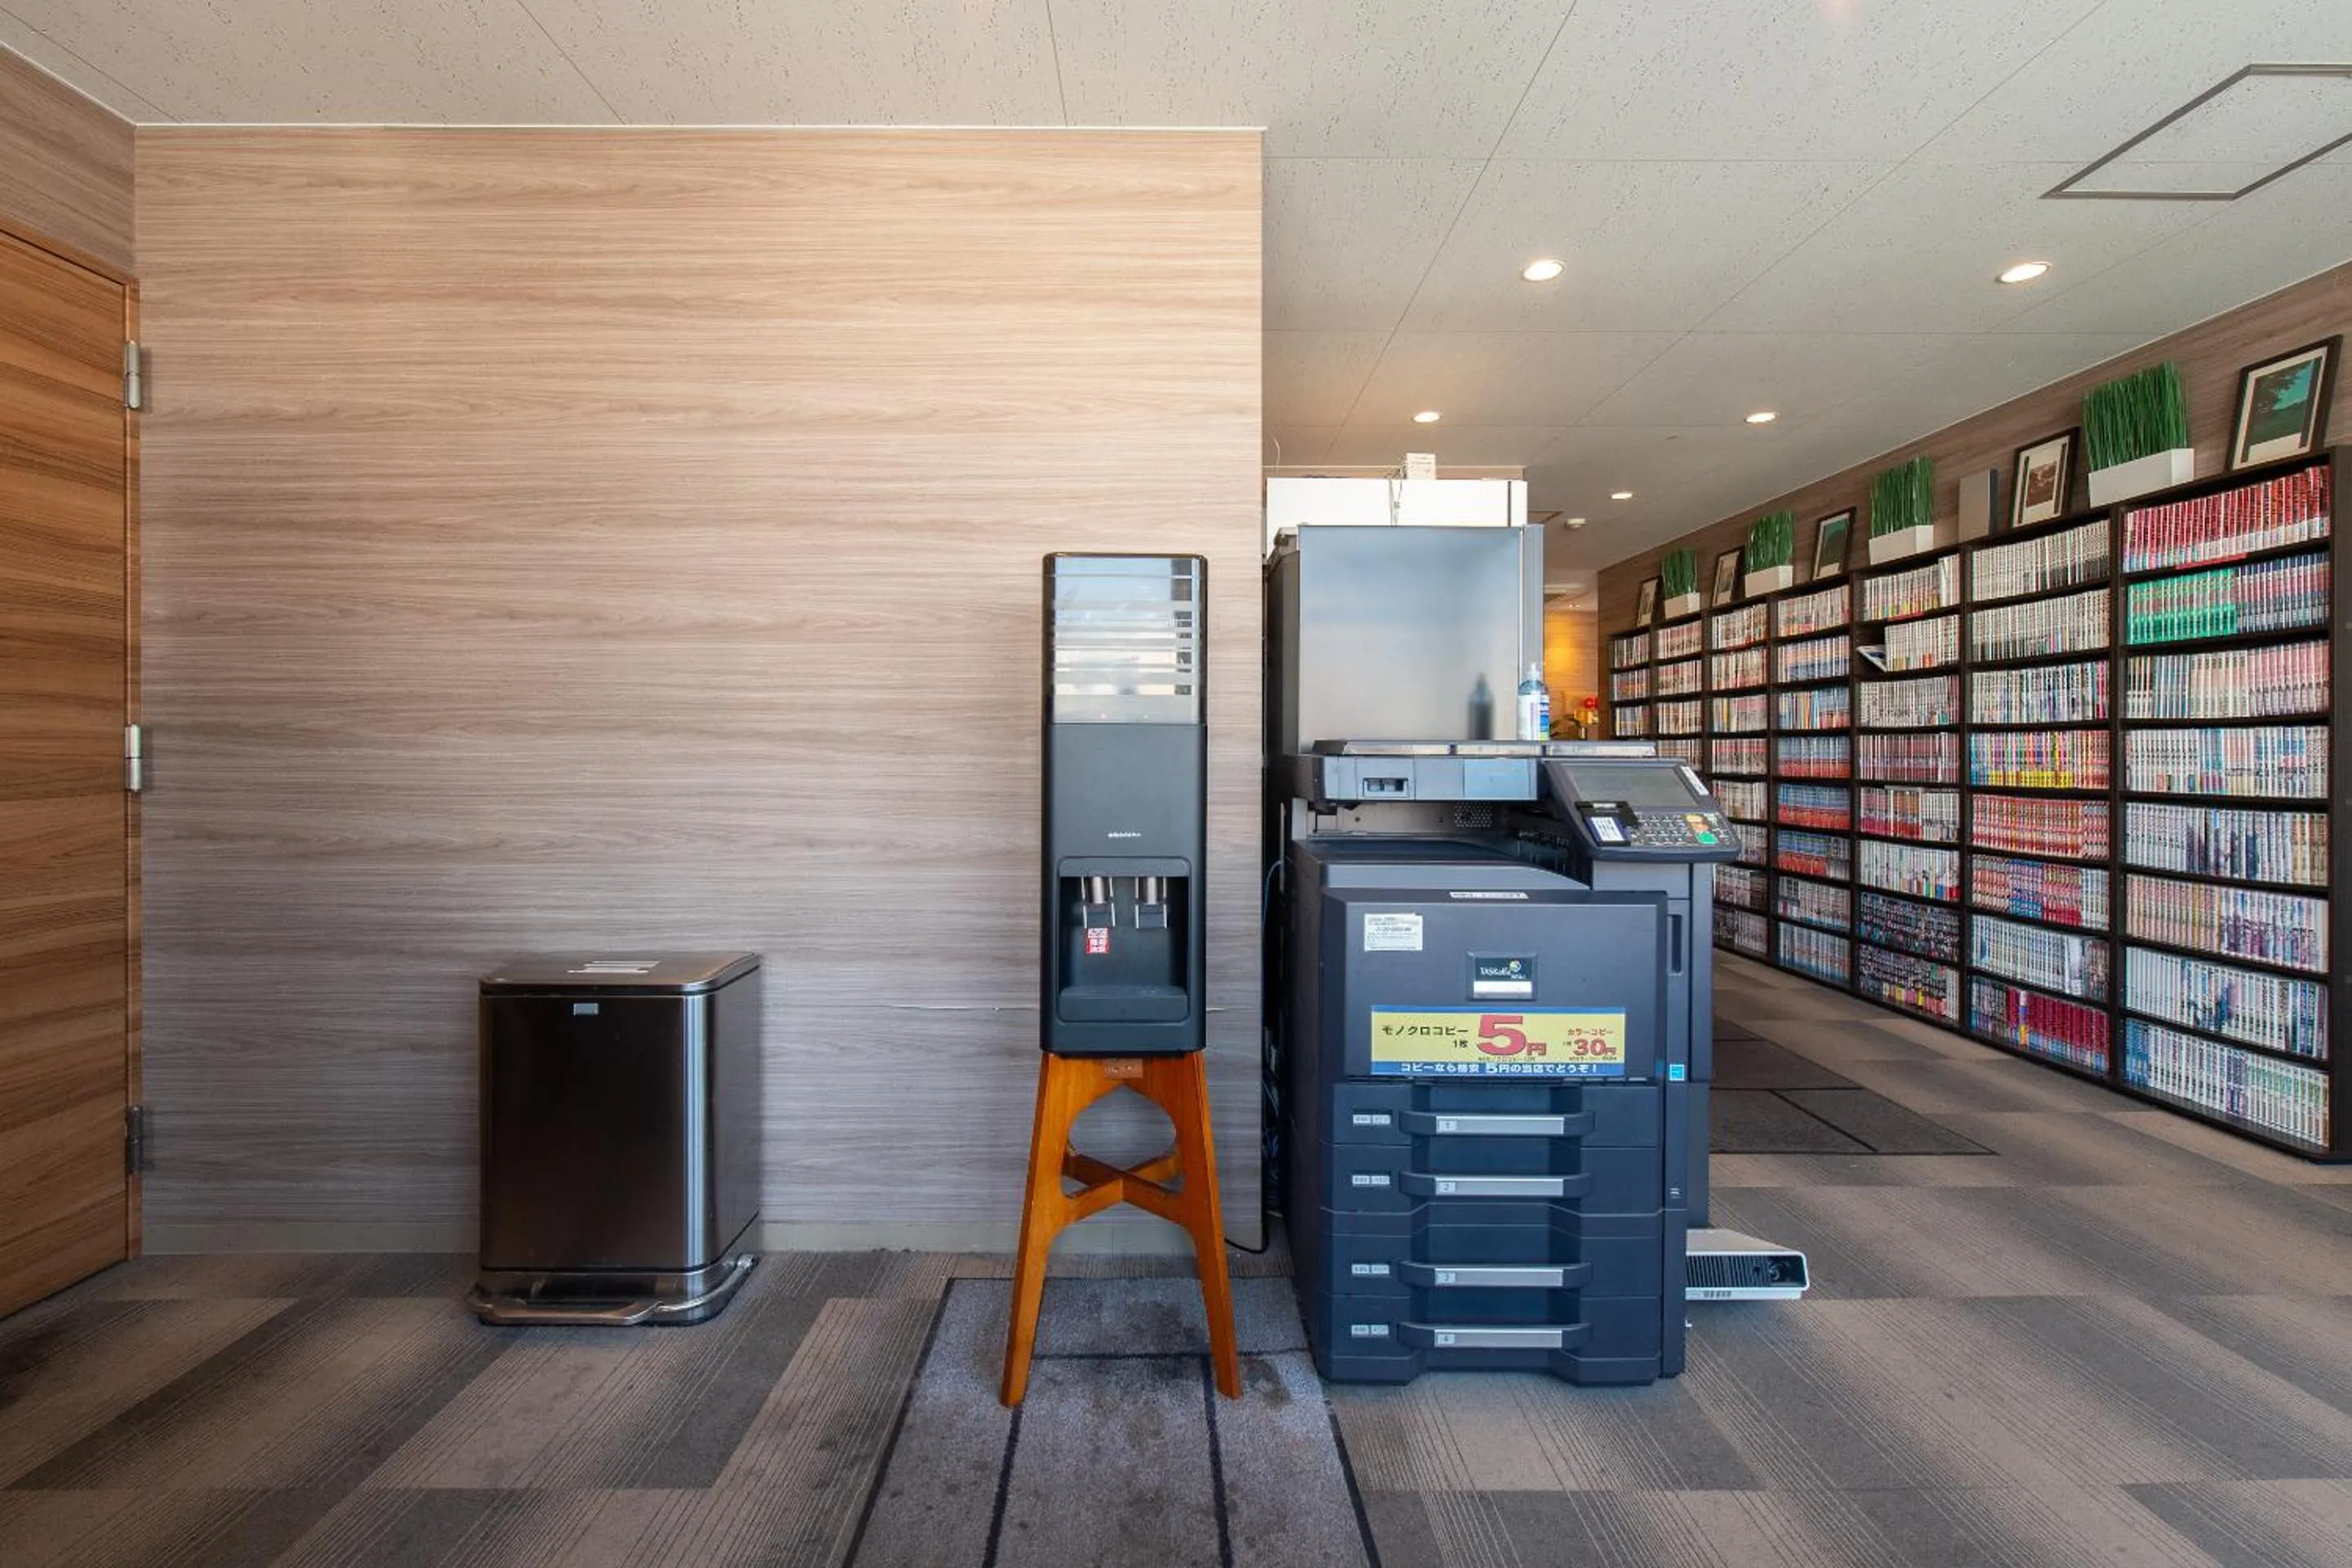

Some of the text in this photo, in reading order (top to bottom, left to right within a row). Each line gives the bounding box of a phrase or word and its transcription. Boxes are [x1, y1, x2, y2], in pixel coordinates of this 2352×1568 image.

[1382, 1026, 1468, 1036] モノクロコピー
[1477, 1014, 1547, 1056] 5円
[1567, 1028, 1615, 1036] カラーコピー
[1573, 1038, 1617, 1056] 30円
